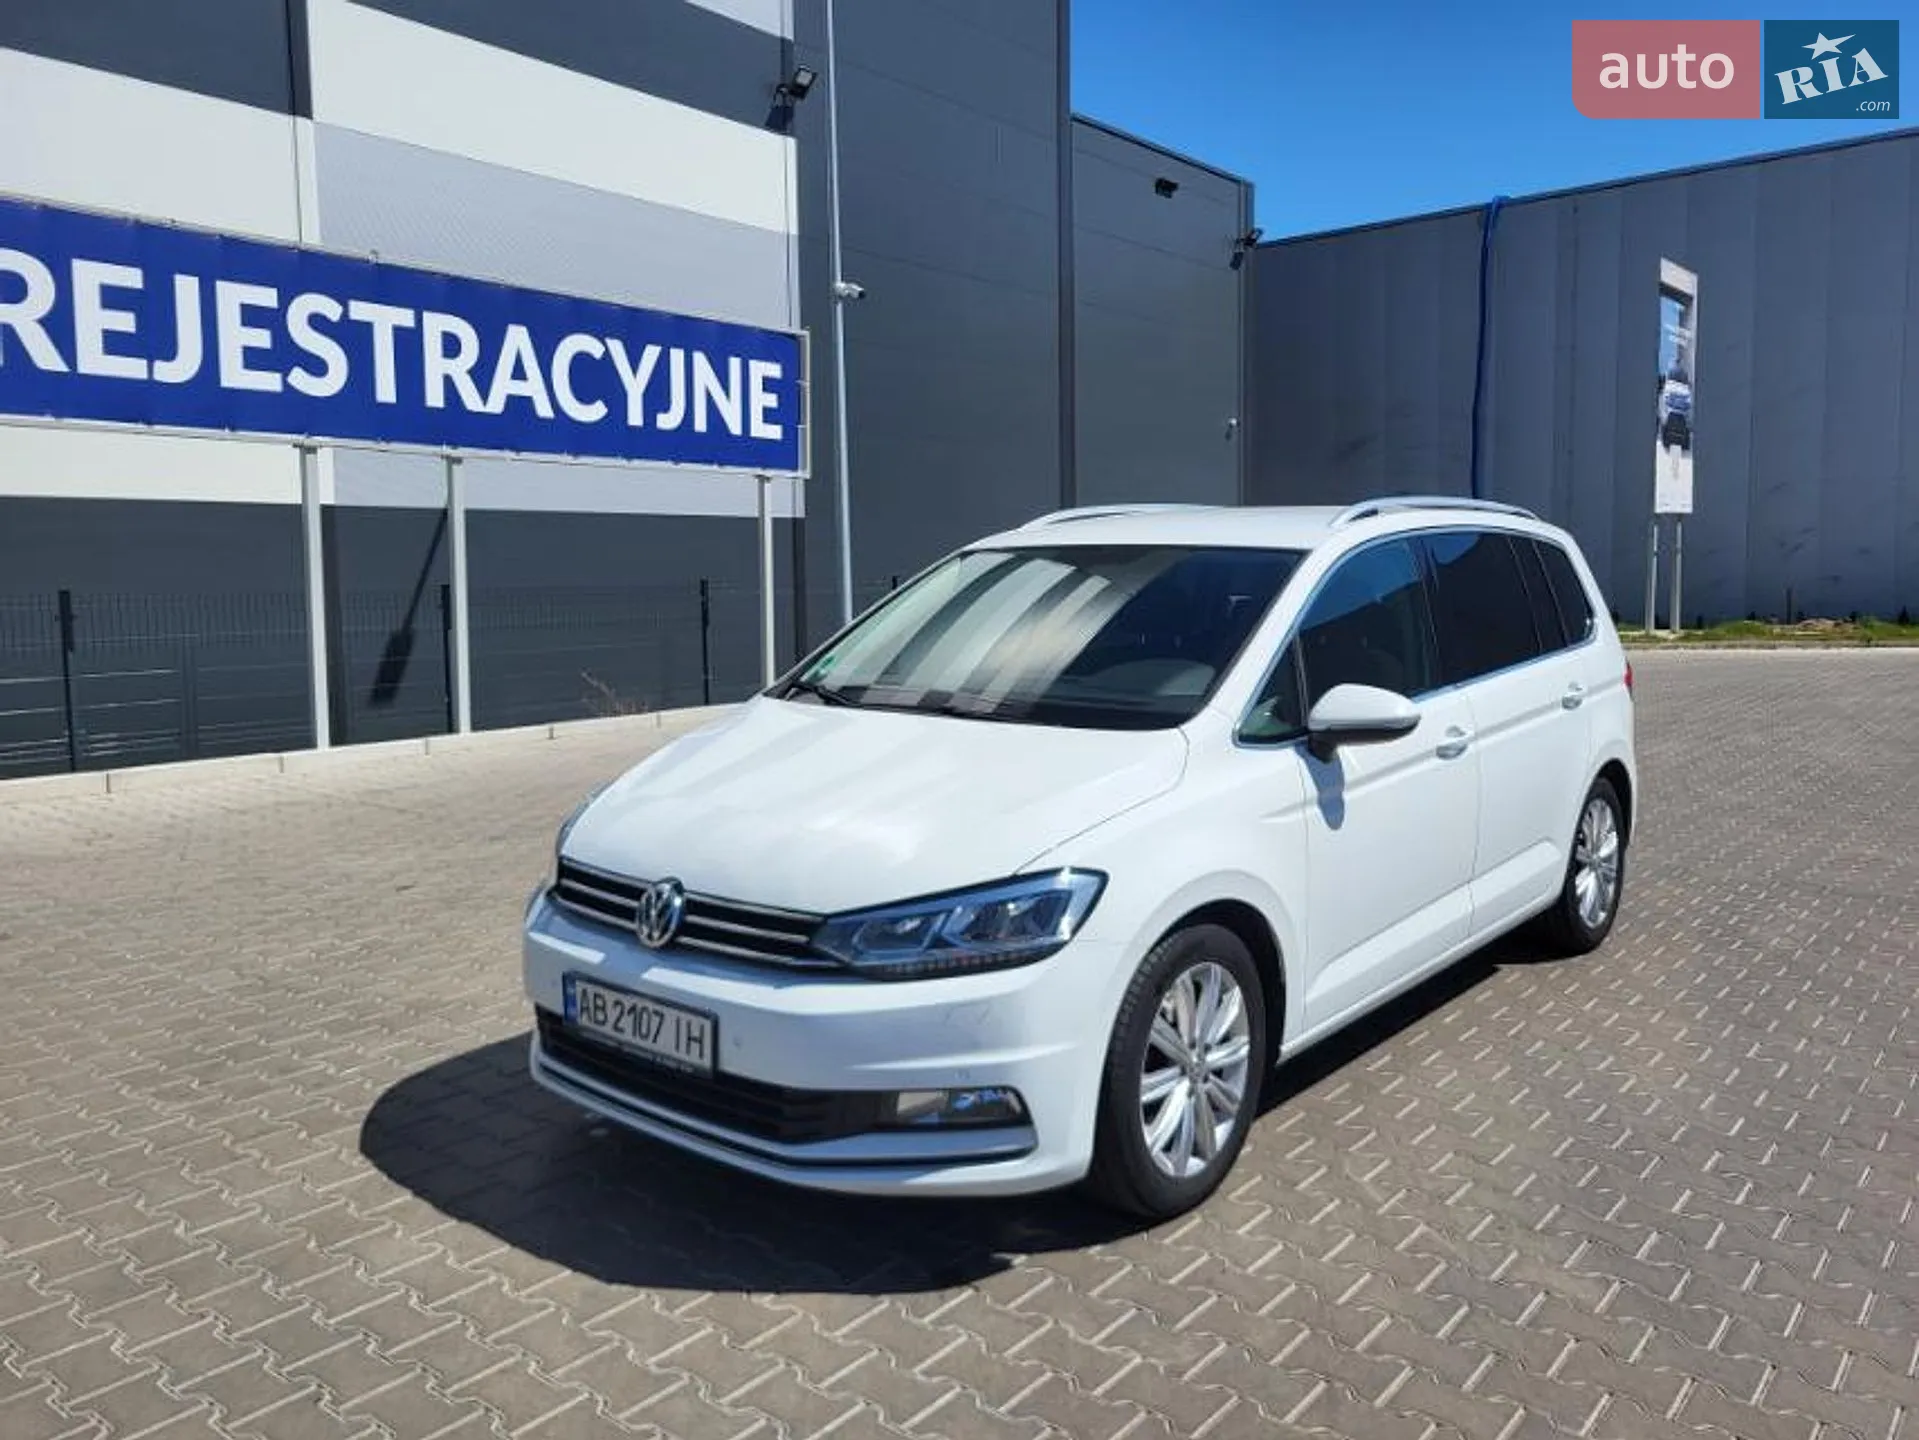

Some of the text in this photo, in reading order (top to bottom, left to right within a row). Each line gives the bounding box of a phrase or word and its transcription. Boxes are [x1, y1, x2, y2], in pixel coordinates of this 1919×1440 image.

[0, 248, 783, 440] REJESTRACYJNE
[579, 987, 705, 1061] AB 2107 IH
